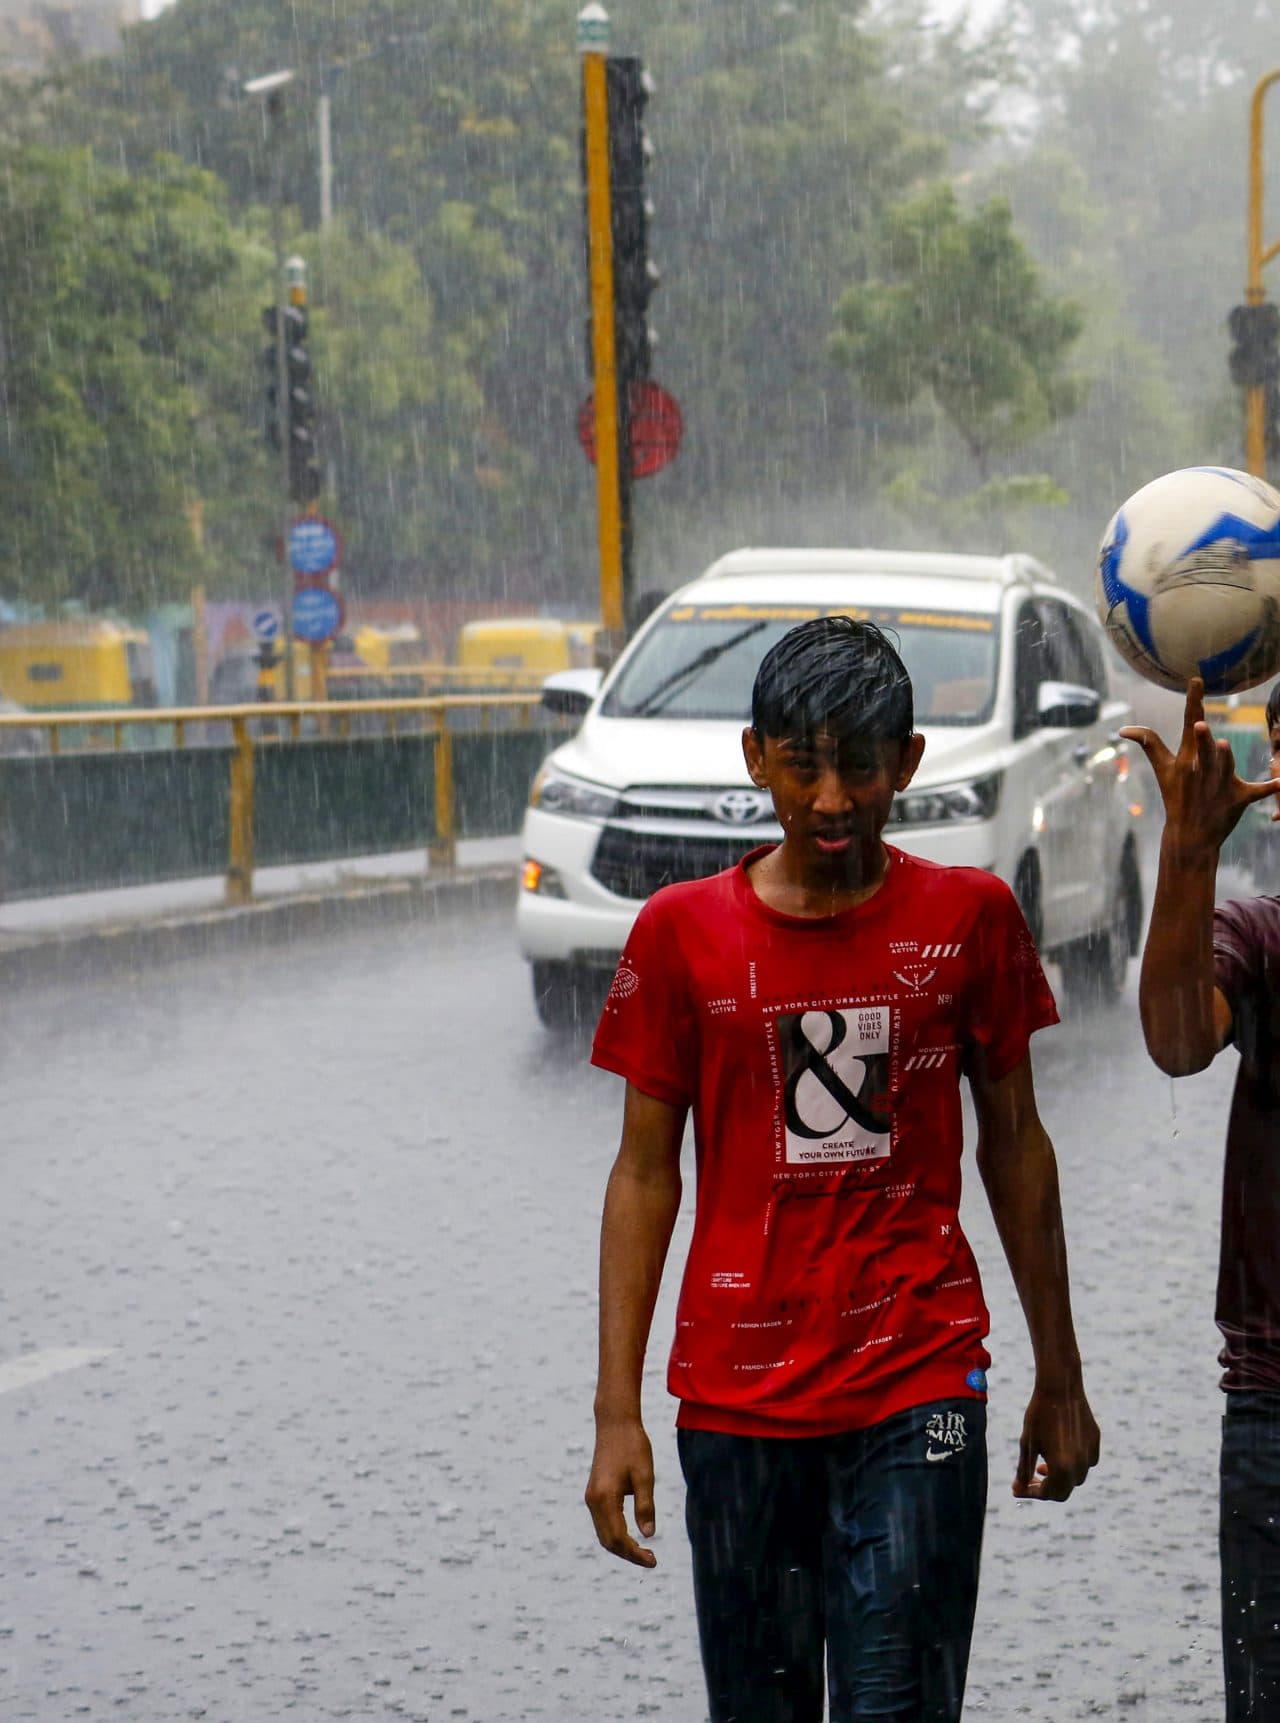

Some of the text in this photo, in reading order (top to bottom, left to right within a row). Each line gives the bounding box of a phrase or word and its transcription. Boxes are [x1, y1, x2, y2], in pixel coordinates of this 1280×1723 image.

[891, 946, 919, 954] ACTIVE
[707, 998, 737, 1007] CASUAL
[762, 1005, 782, 1014] NEW
[784, 1001, 809, 1010] YORK
[811, 999, 833, 1007] CITY
[836, 995, 868, 1004] URBAN
[870, 993, 899, 1002] STYLE
[711, 1005, 737, 1015] ACTIVE
[858, 1012, 881, 1021] GOOD
[893, 1008, 901, 1029] NEW
[857, 1021, 882, 1031] VIBES
[765, 1021, 776, 1051] STYLE
[859, 1031, 880, 1040] ONLY
[892, 1030, 900, 1056] YORK
[769, 1054, 780, 1086] URBAN
[891, 1060, 899, 1084] CITY
[822, 1141, 855, 1150] CREATE
[799, 1146, 877, 1159] YOUR OWN FUTURE
[870, 1296, 891, 1309] LEAER
[871, 1336, 893, 1345] LEADER
[926, 1411, 968, 1436] AIR
[925, 1429, 966, 1447] MAX
